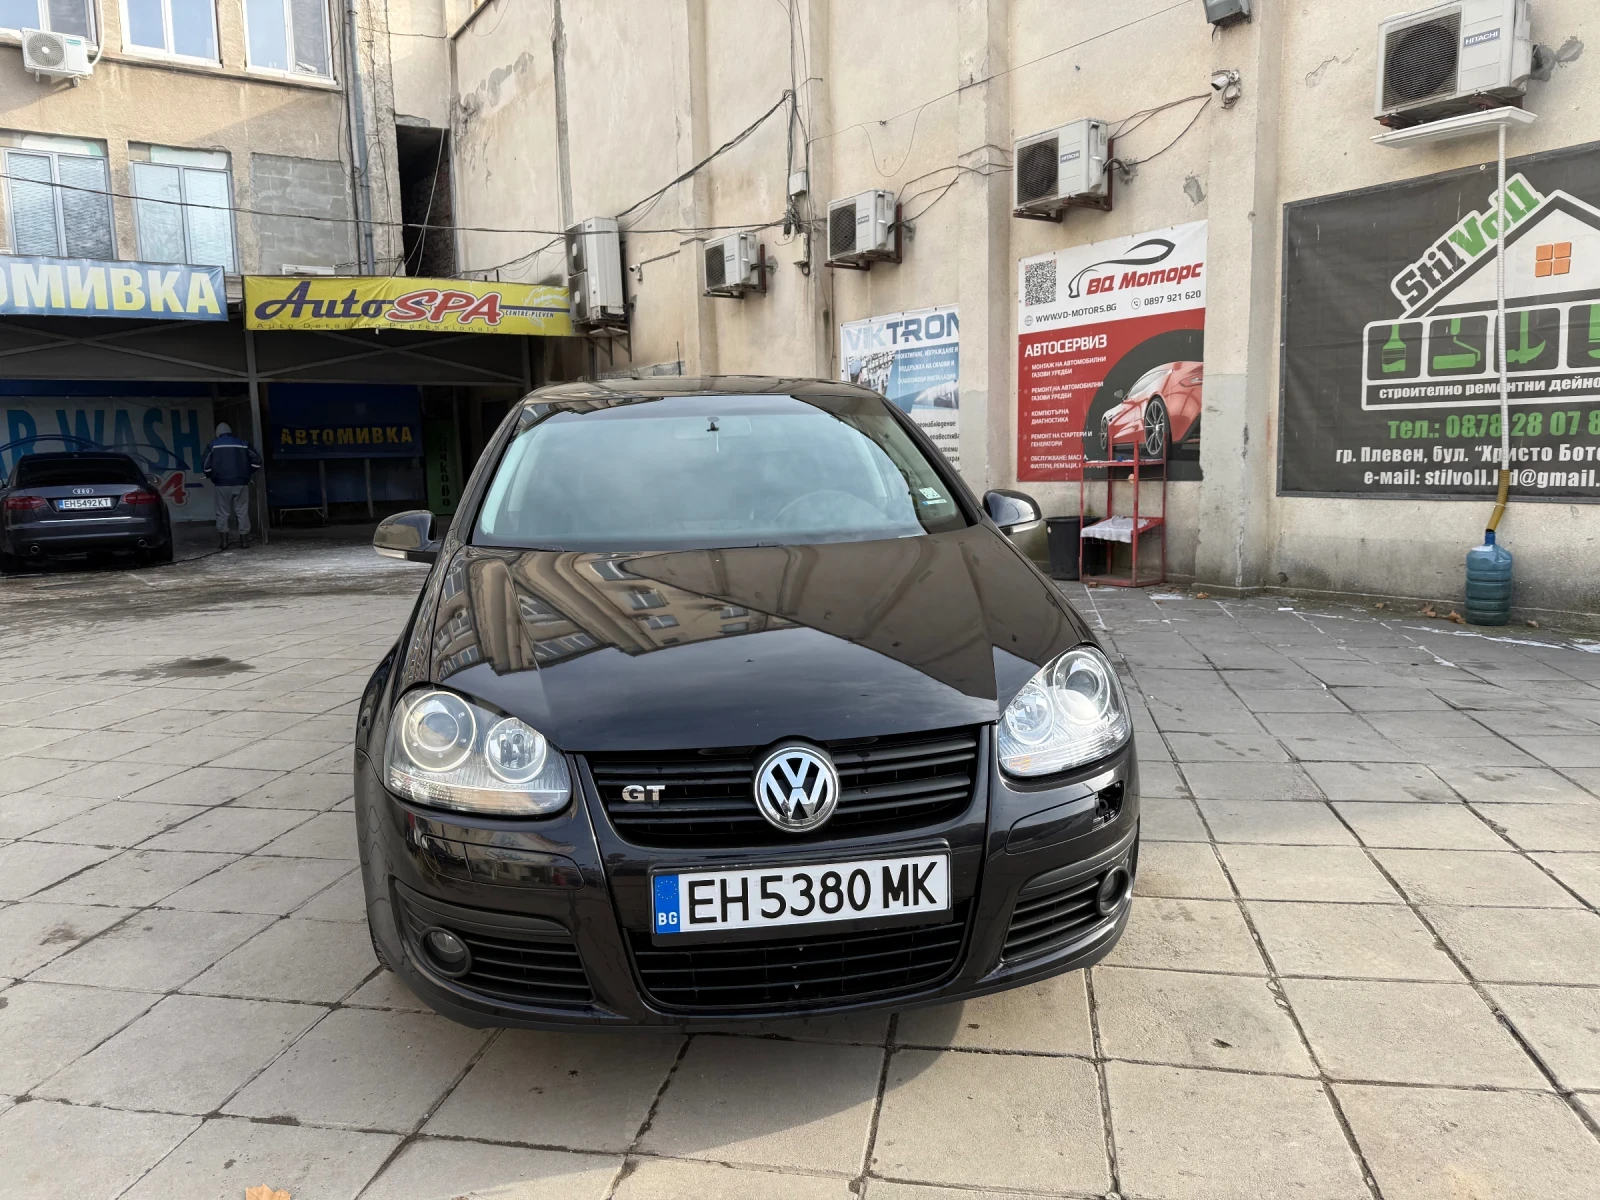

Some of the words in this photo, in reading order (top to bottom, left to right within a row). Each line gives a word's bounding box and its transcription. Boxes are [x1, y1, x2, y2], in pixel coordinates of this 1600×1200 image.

[1464, 30, 1498, 45] HITACHI
[1395, 178, 1541, 308] StilVoll
[1086, 275, 1115, 296] ВД
[1118, 262, 1204, 290] Моторс
[254, 280, 385, 320] Auto
[384, 289, 504, 326] SPA
[1144, 296, 1164, 306] 0897
[1166, 294, 1182, 303] 921
[1184, 290, 1202, 300] 620
[1036, 303, 1117, 324] WWW.VD-MOTORS.BG
[845, 312, 959, 351] VIKTRON
[1024, 334, 1107, 358] АВТОСЕРВИЗ
[1064, 356, 1106, 366] АВТОМОБИЛНИ
[1051, 368, 1072, 376] УРЕДБИ
[1061, 380, 1104, 391] АВТОМОБИЛНИ
[1379, 384, 1462, 400] строително
[1032, 408, 1069, 416] КОМПЮТЪРНА
[1031, 417, 1069, 426] ДИАГНОСТИКА
[1388, 420, 1440, 438] тел.:
[1446, 414, 1502, 438] 0878
[1510, 412, 1543, 436] 28
[1550, 411, 1580, 436] 07
[281, 427, 412, 445] АВТОМИВКА
[1336, 449, 1356, 464] гр.
[1360, 446, 1428, 464] Плевен,
[1432, 446, 1469, 464] бул.
[1424, 468, 1600, 488] stilvoll.ld@gmail.
[622, 785, 666, 804] GT
[658, 912, 678, 926] BG
